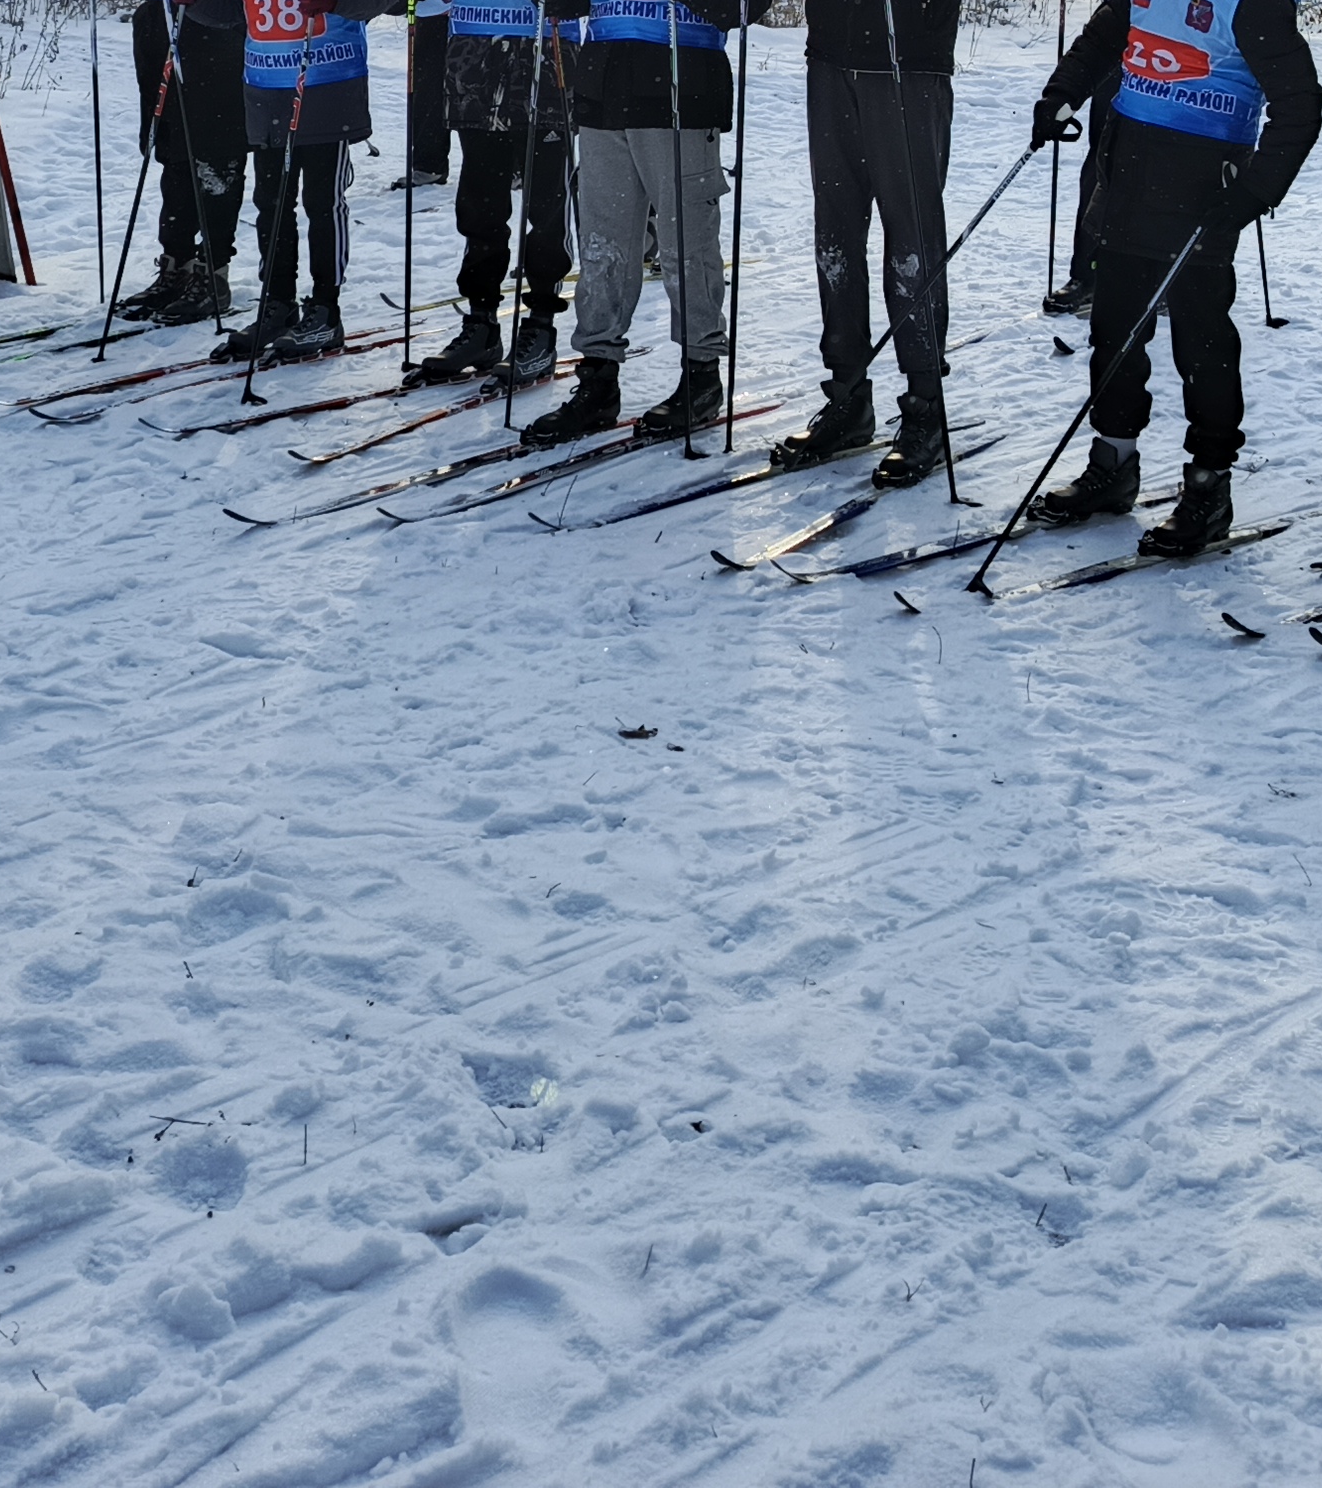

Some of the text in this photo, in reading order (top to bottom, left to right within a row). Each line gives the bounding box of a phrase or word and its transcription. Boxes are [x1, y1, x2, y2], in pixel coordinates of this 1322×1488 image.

[307, 42, 355, 65] РАЙОН
[1174, 87, 1236, 114] РАЙОН
[994, 164, 1023, 199] NORDWAY
